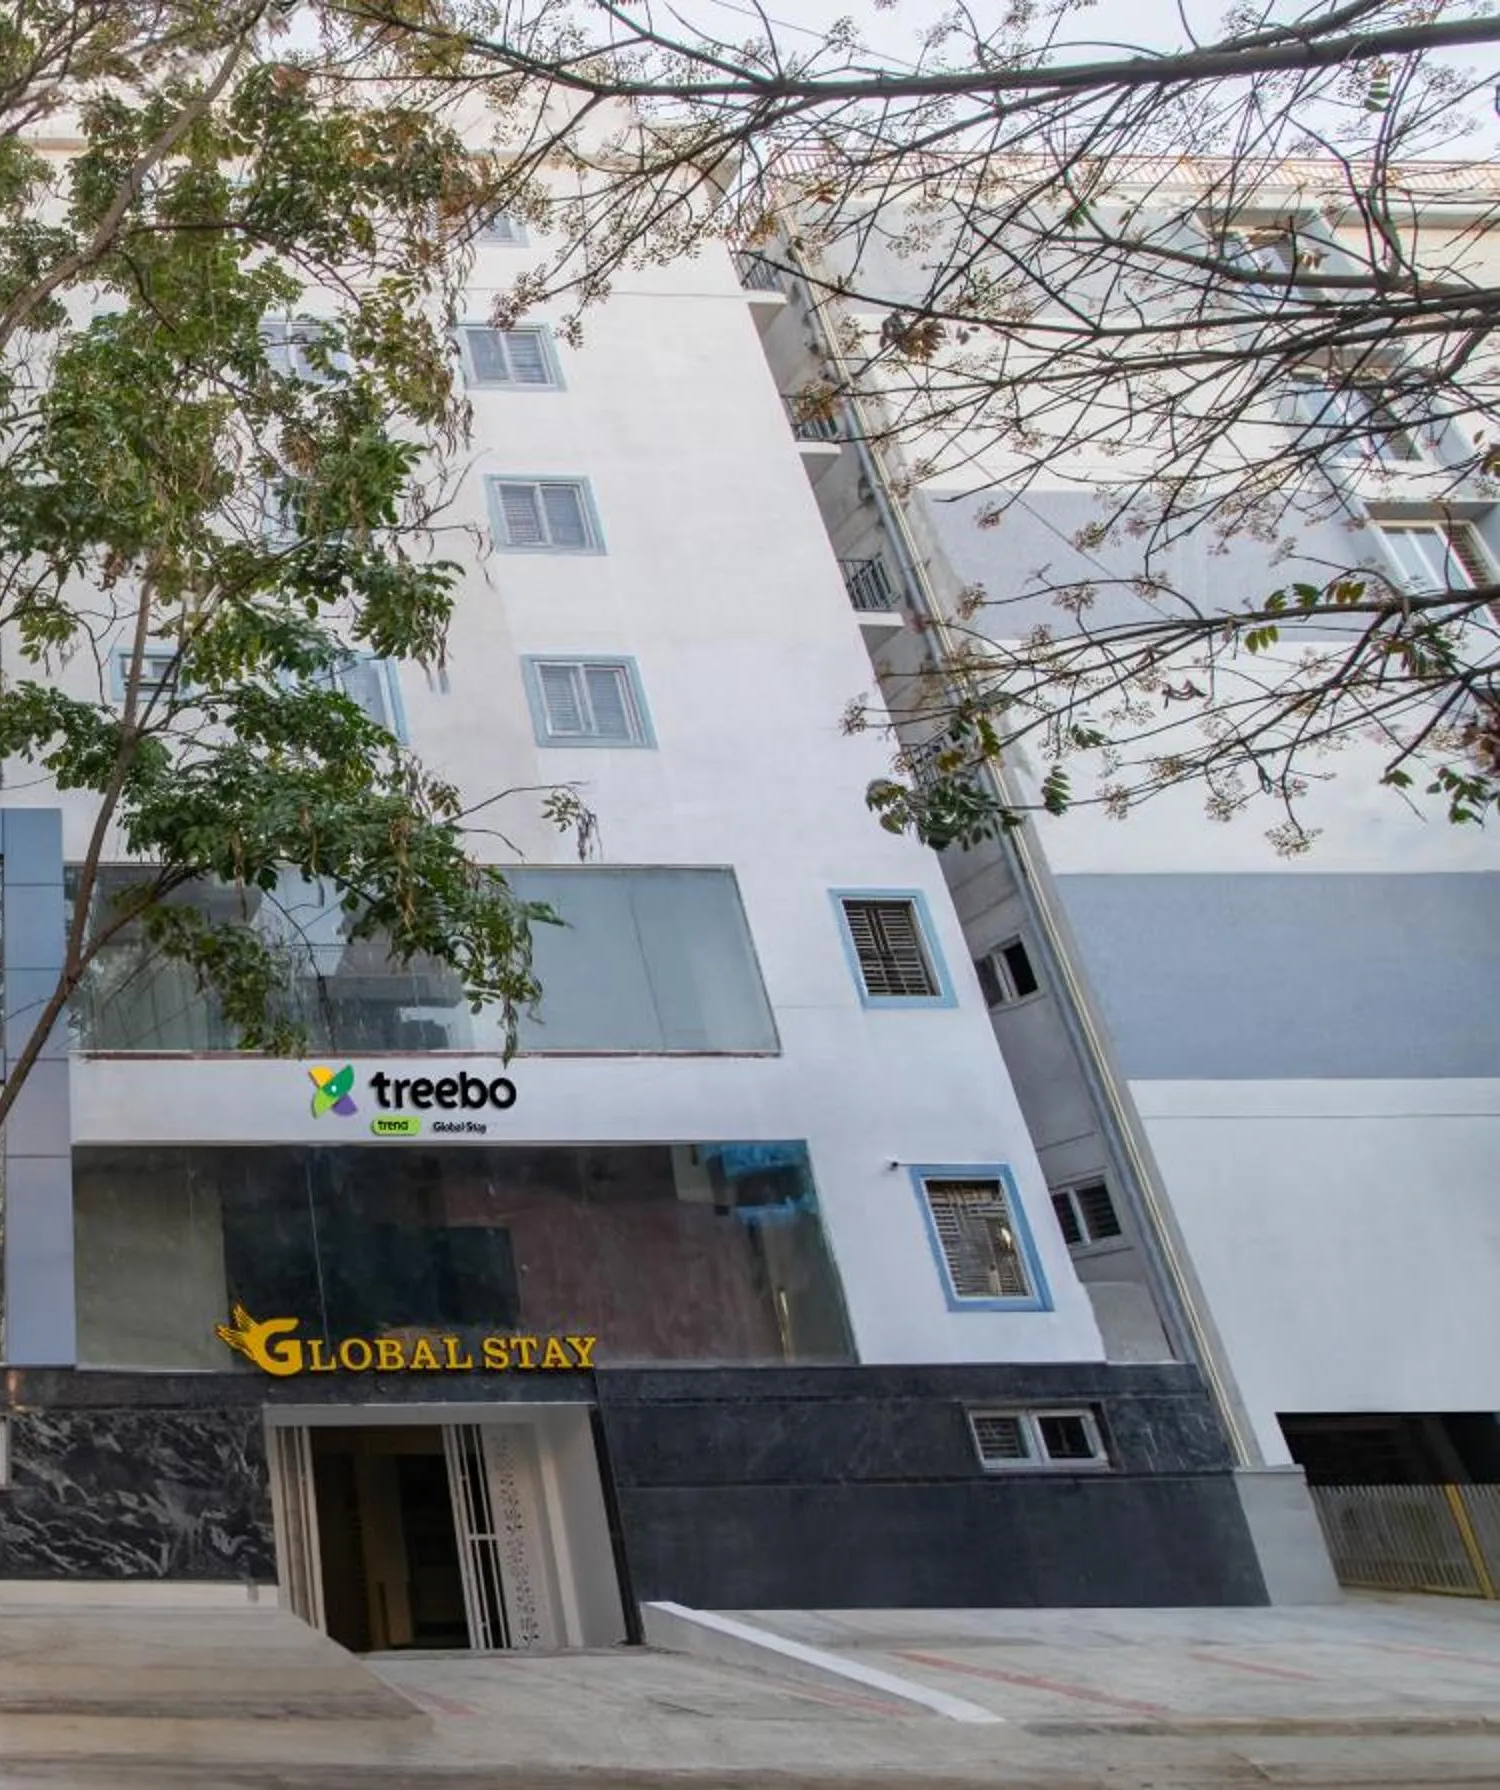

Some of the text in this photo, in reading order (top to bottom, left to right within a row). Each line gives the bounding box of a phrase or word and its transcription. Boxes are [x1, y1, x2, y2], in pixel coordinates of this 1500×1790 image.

[370, 1071, 517, 1109] treebo
[377, 1119, 409, 1131] trend
[433, 1121, 487, 1134] Global Stay
[242, 1316, 597, 1376] GLOBAL STAY
